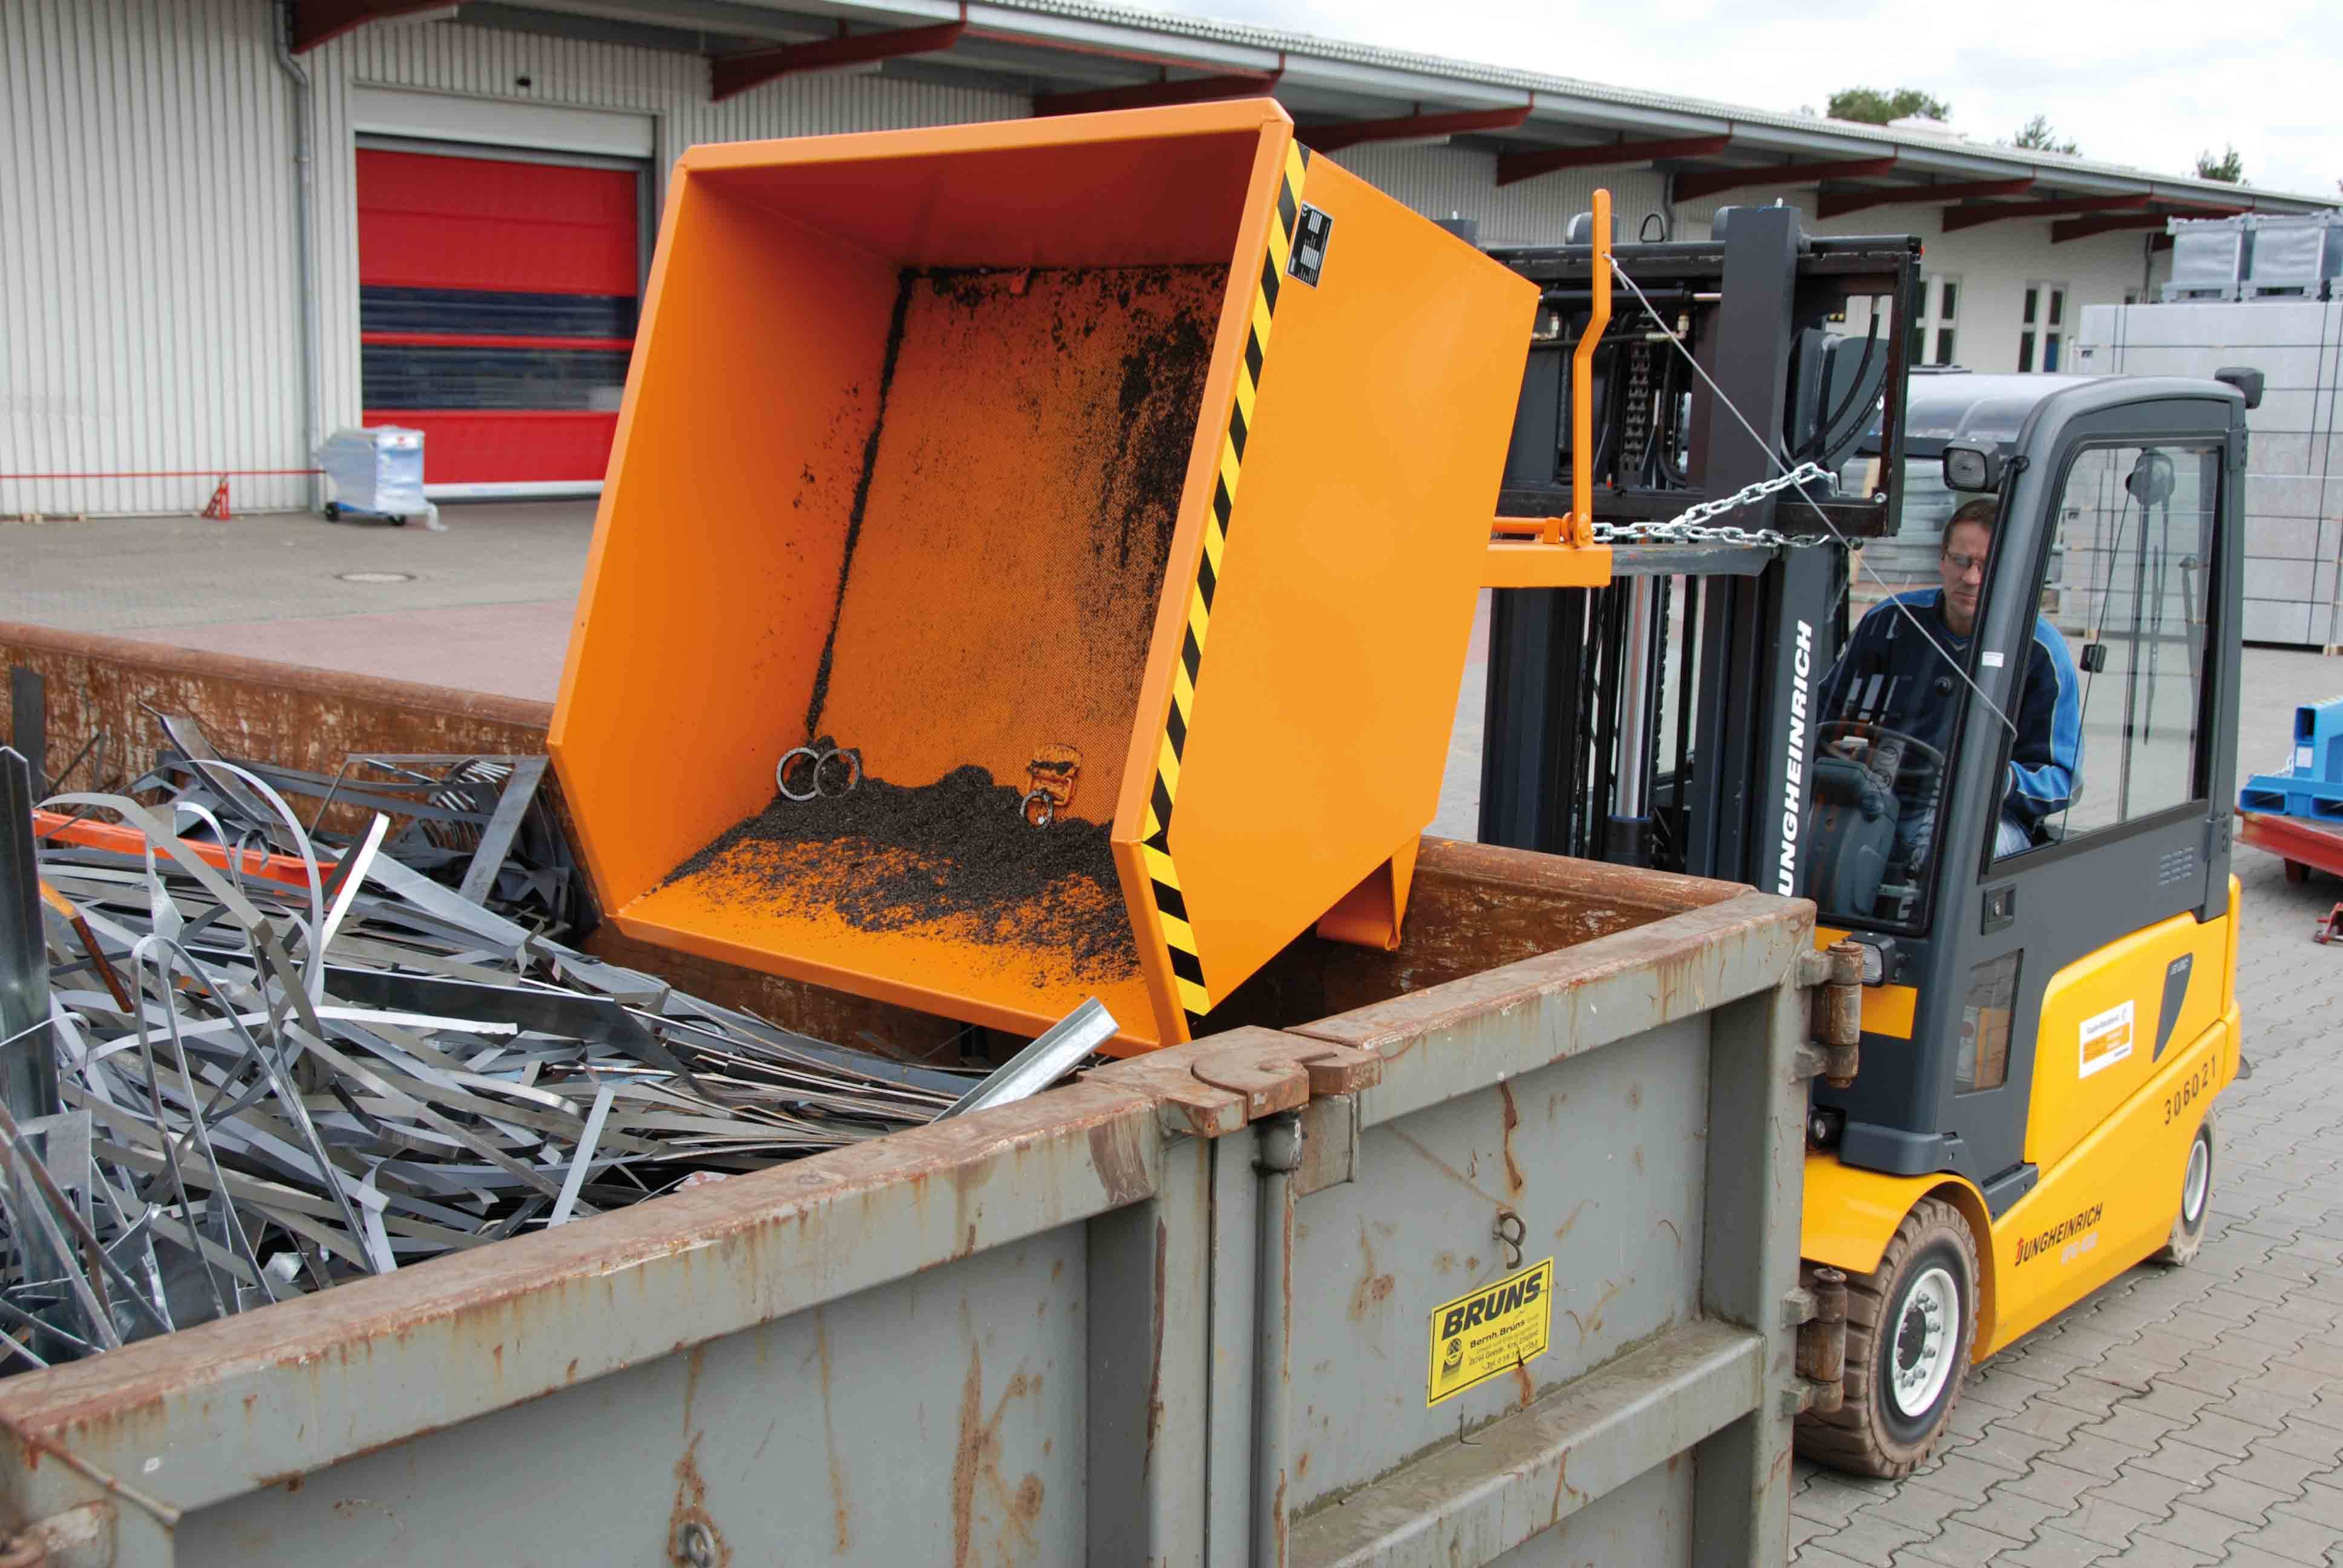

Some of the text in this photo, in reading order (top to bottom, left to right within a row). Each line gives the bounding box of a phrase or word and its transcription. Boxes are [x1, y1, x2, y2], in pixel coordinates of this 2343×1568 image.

[1778, 619, 1812, 898] UNGHEINRICH
[2164, 1054, 2216, 1126] 306021
[2014, 1201, 2103, 1267] JUNGHEINRICH
[1441, 1271, 1543, 1341] BRUNS
[1500, 1319, 1525, 1335] Bruns
